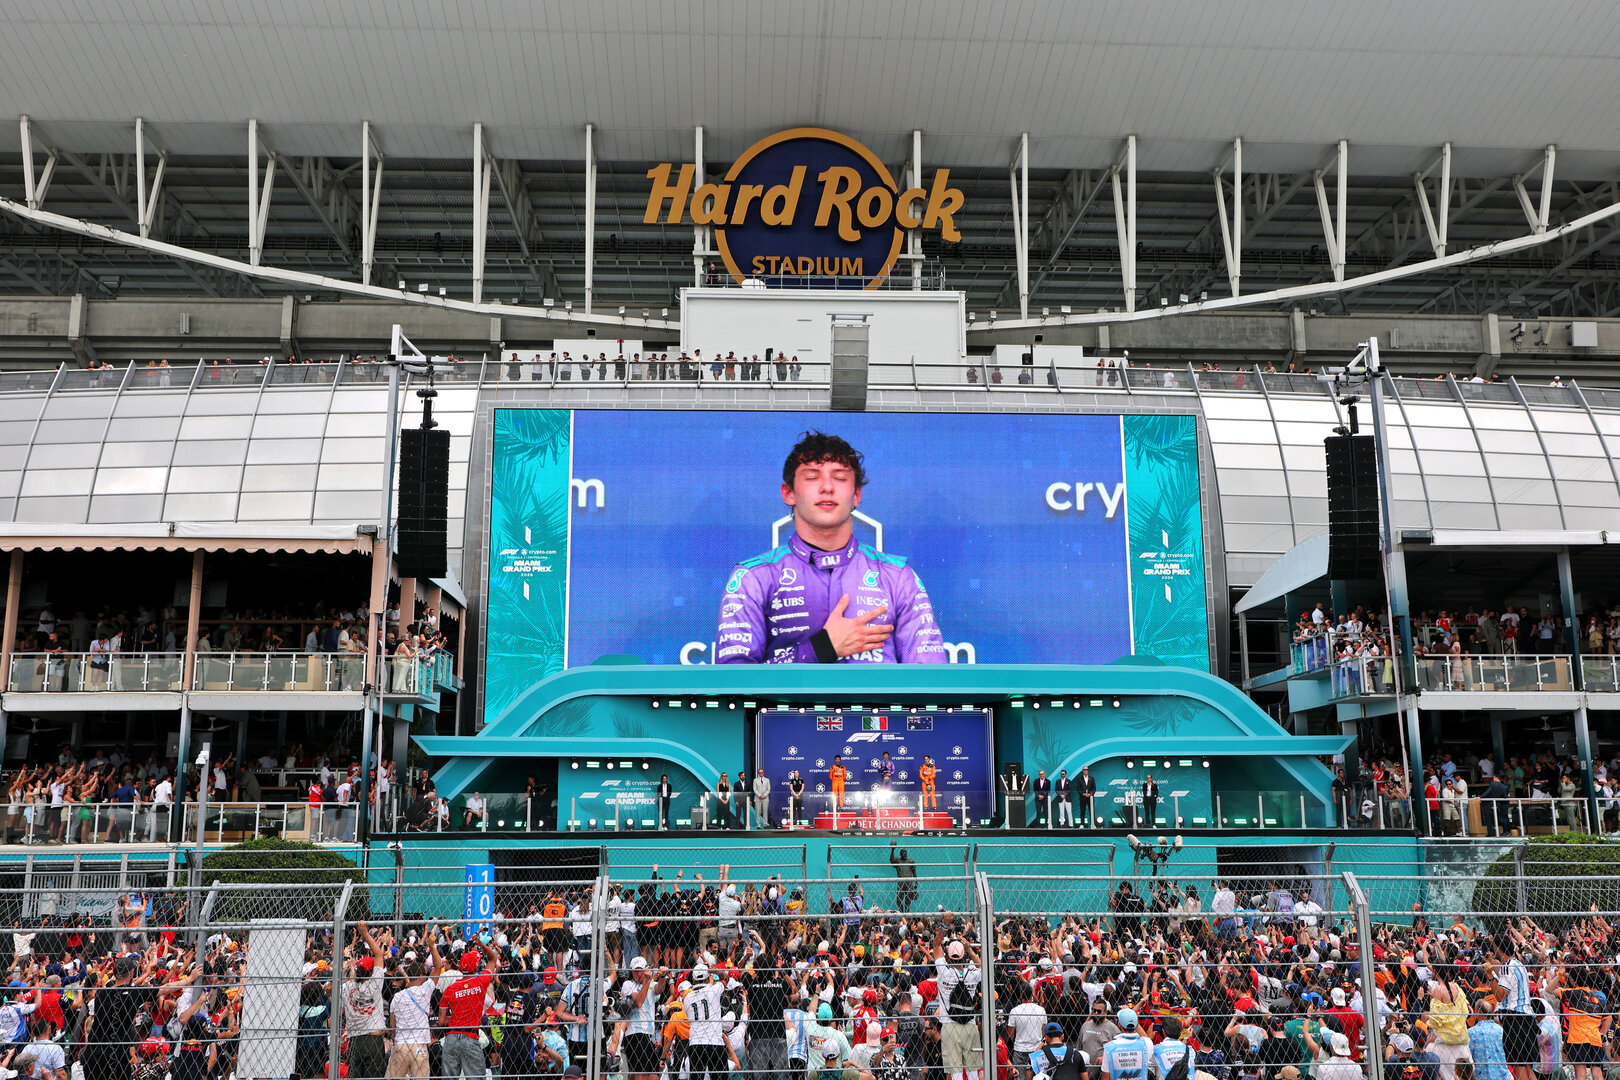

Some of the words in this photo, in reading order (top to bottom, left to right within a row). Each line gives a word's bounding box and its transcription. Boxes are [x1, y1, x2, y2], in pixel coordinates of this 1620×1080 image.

[643, 163, 807, 226] Hard
[814, 166, 965, 242] Rock
[751, 255, 863, 276] STADIUM
[783, 597, 805, 607] UBS
[856, 596, 888, 607] INEOS
[455, 986, 482, 999] Ferrari
[690, 998, 710, 1020] 11
